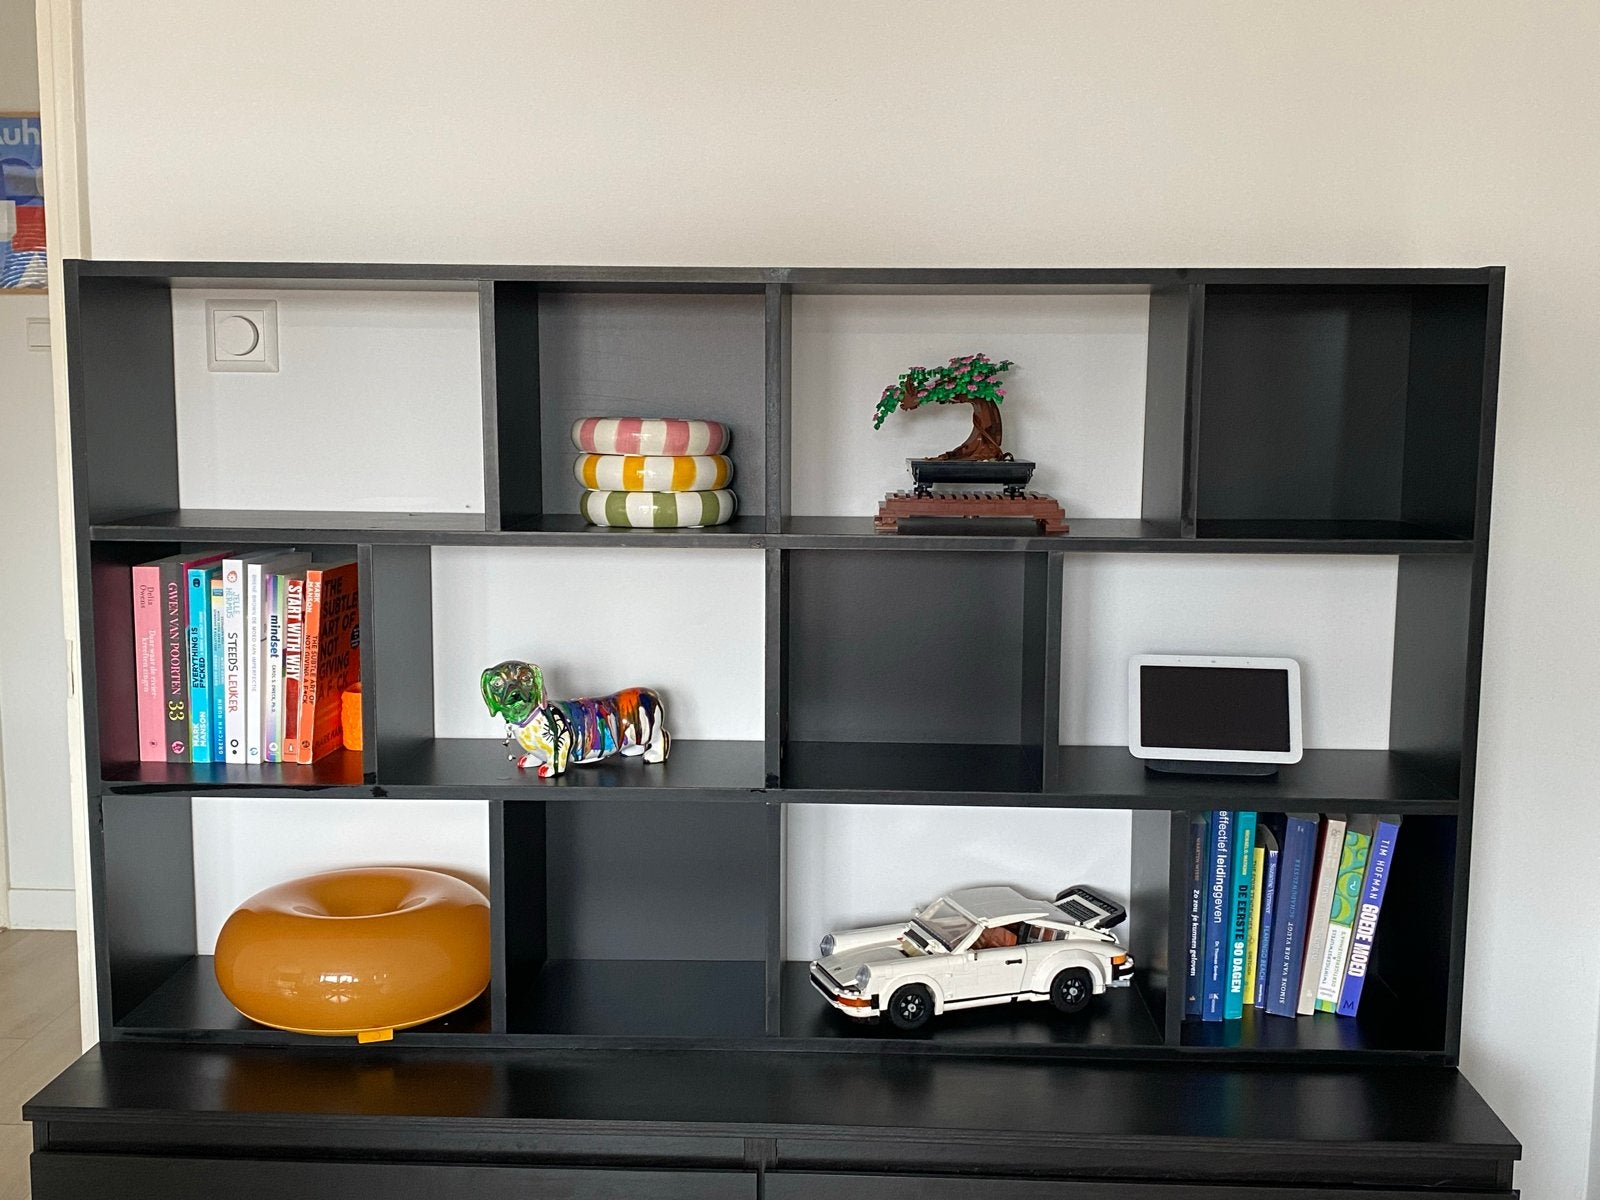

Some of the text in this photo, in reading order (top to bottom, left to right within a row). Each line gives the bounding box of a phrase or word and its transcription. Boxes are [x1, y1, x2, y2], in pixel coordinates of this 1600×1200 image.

[0, 118, 40, 146] uh
[306, 581, 314, 613] MANSON
[313, 581, 321, 603] MARK
[323, 576, 343, 598] THE
[225, 587, 234, 619] HERMUS
[231, 592, 240, 615] JELLE
[321, 591, 358, 617] SUBTLE
[191, 627, 198, 635] IS
[270, 615, 280, 658] mindset
[286, 584, 302, 681] START WITH WHY
[321, 616, 340, 638] ART
[342, 611, 356, 632] OF
[167, 582, 184, 721] GWEN VAN POORTEN 33
[320, 638, 339, 658] NOT
[227, 632, 239, 713] STEEDS LEUKER
[319, 652, 350, 680] GIVING
[308, 695, 315, 705] OF
[1213, 810, 1229, 924] effectief leidinggeven
[1369, 839, 1390, 900] TIM HOFMAN
[1193, 889, 1200, 899] Zo
[1190, 914, 1198, 922] je
[1231, 884, 1248, 993] DE EERSTE 90 DAGEN
[1261, 925, 1269, 959] FLAMINGO
[1347, 903, 1379, 978] GOEDE MOED
[1189, 949, 1197, 976] geloven
[1259, 959, 1267, 980] BEACH
[1279, 977, 1288, 1004] SIMONE
[1286, 922, 1294, 945] VLUGT
